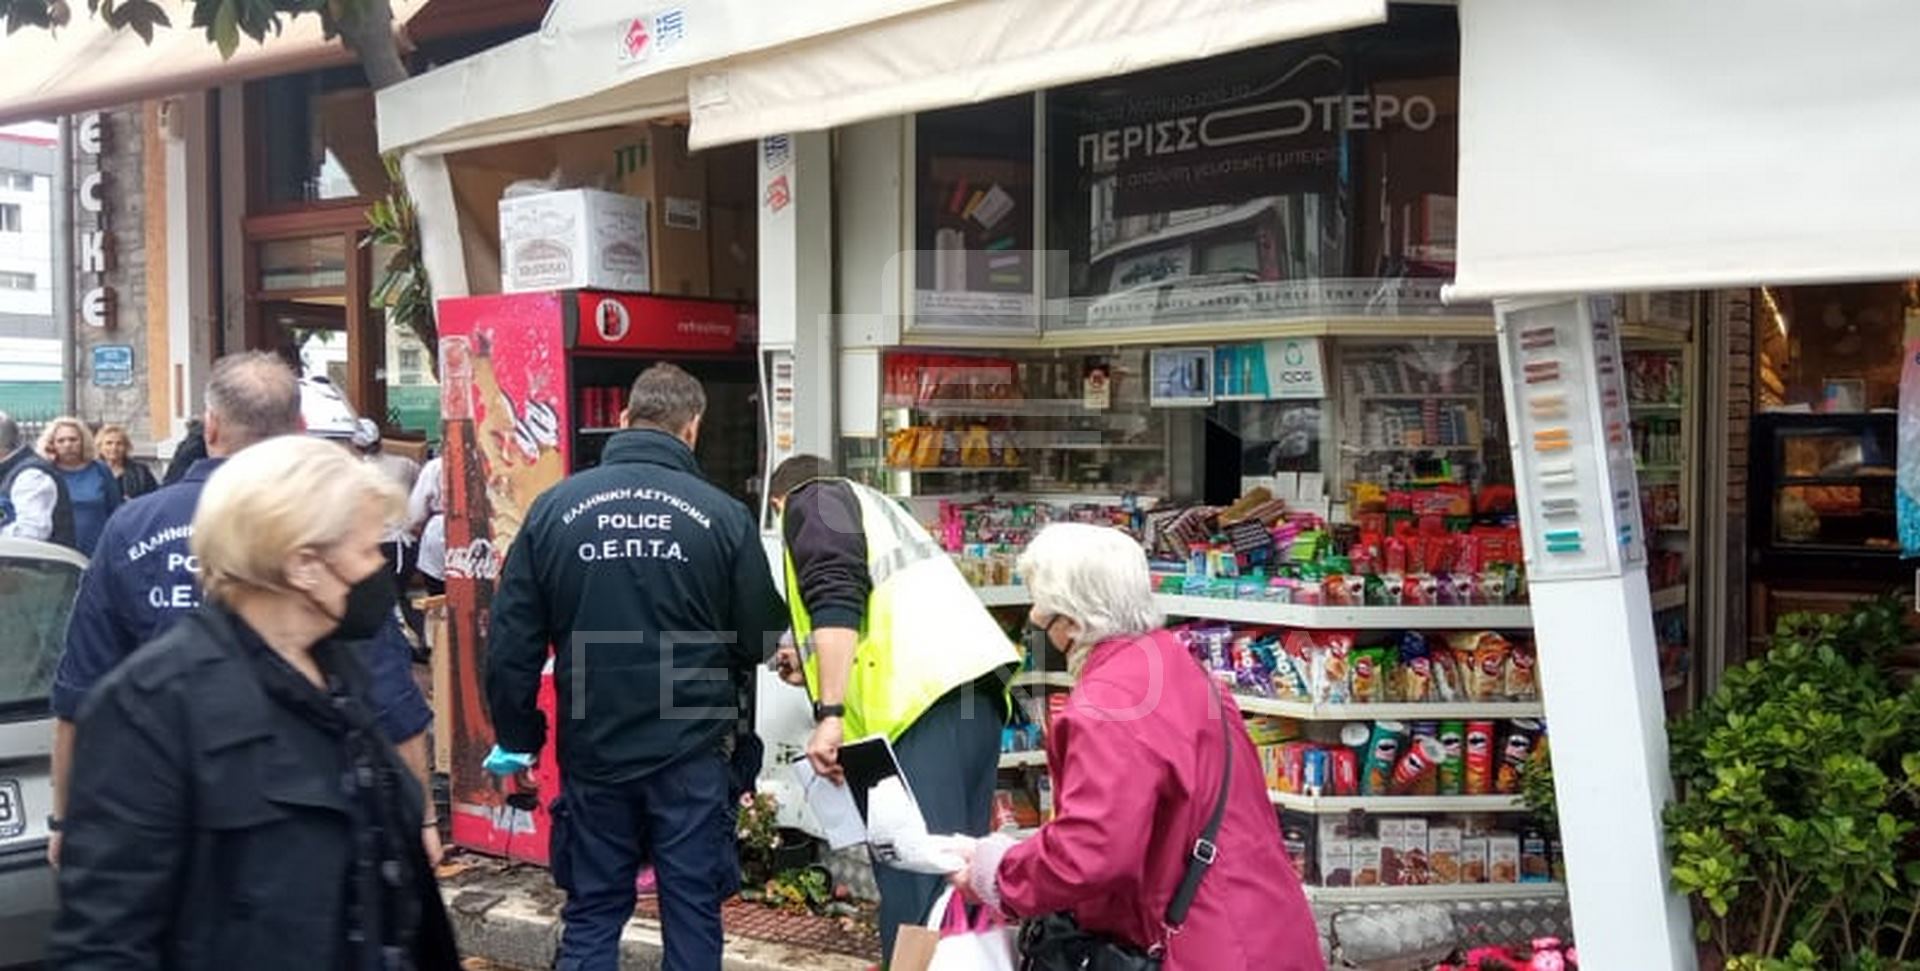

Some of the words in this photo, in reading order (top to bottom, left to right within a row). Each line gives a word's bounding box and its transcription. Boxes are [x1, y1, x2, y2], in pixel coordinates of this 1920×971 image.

[562, 488, 631, 524] ΕΛΛΗΝΙΚΗ
[633, 488, 711, 529] ΑΣΤΥΝΟΜΙΑ
[597, 513, 672, 530] POLICE
